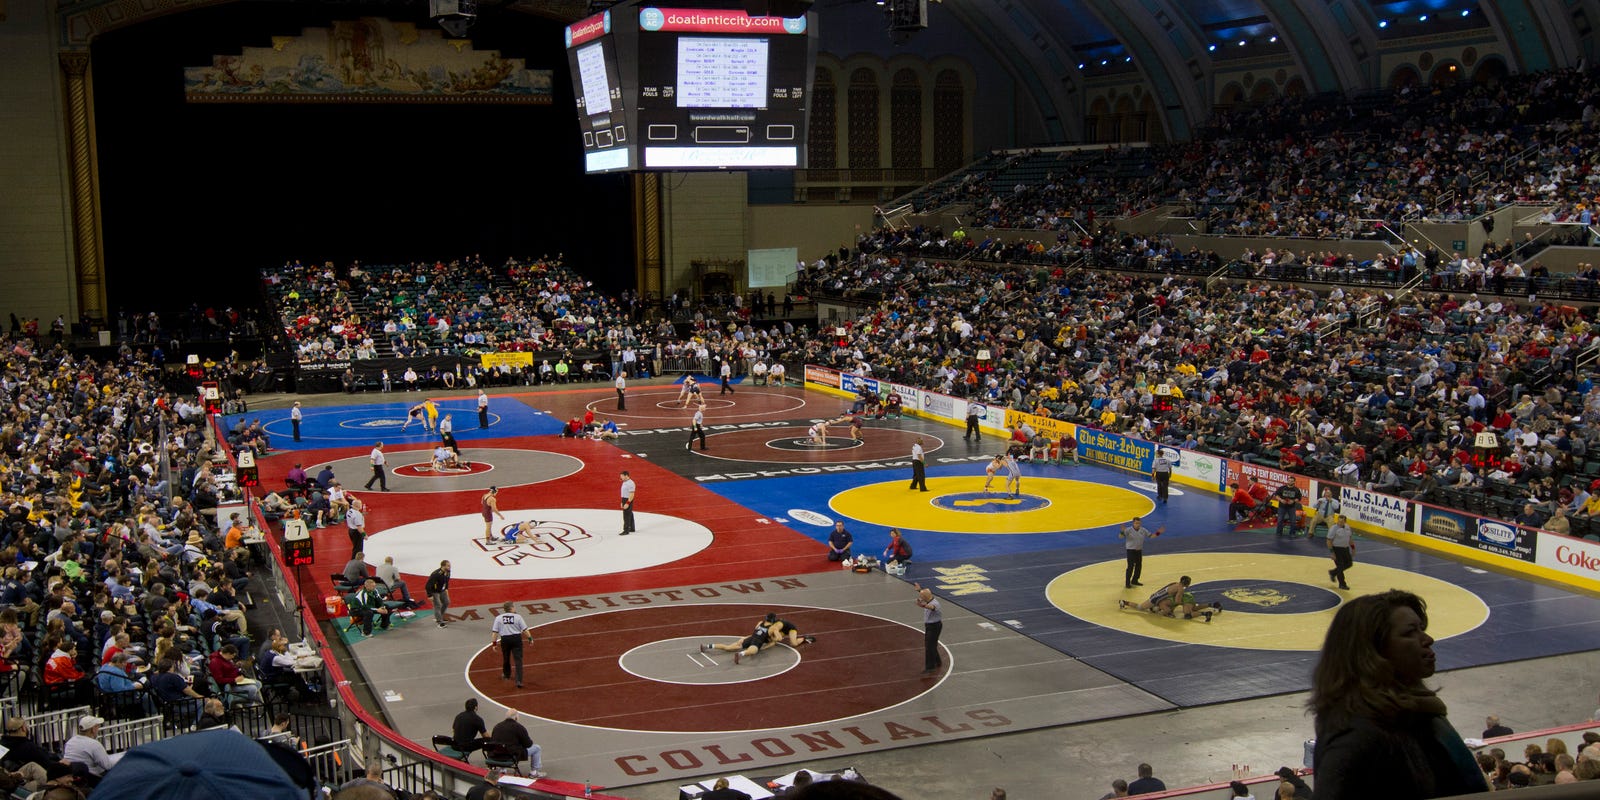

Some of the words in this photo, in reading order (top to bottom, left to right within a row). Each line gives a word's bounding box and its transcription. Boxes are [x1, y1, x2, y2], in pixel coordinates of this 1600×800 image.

[667, 14, 780, 28] doatlanticcity.com
[1079, 429, 1096, 445] The
[1097, 433, 1151, 459] Star-Ledger
[243, 456, 249, 464] 5
[1241, 465, 1257, 476] BOB'S
[1257, 468, 1269, 478] TENT
[1343, 488, 1405, 512] N.J.S.I.A.A.
[1343, 500, 1361, 511] History
[1370, 506, 1383, 516] New
[1385, 509, 1404, 522] Jersey
[1360, 512, 1385, 526] Wrestling
[294, 525, 301, 536] 7
[1556, 545, 1600, 571] Coke
[503, 616, 514, 625] 214
[613, 708, 1013, 777] COLONIALS
